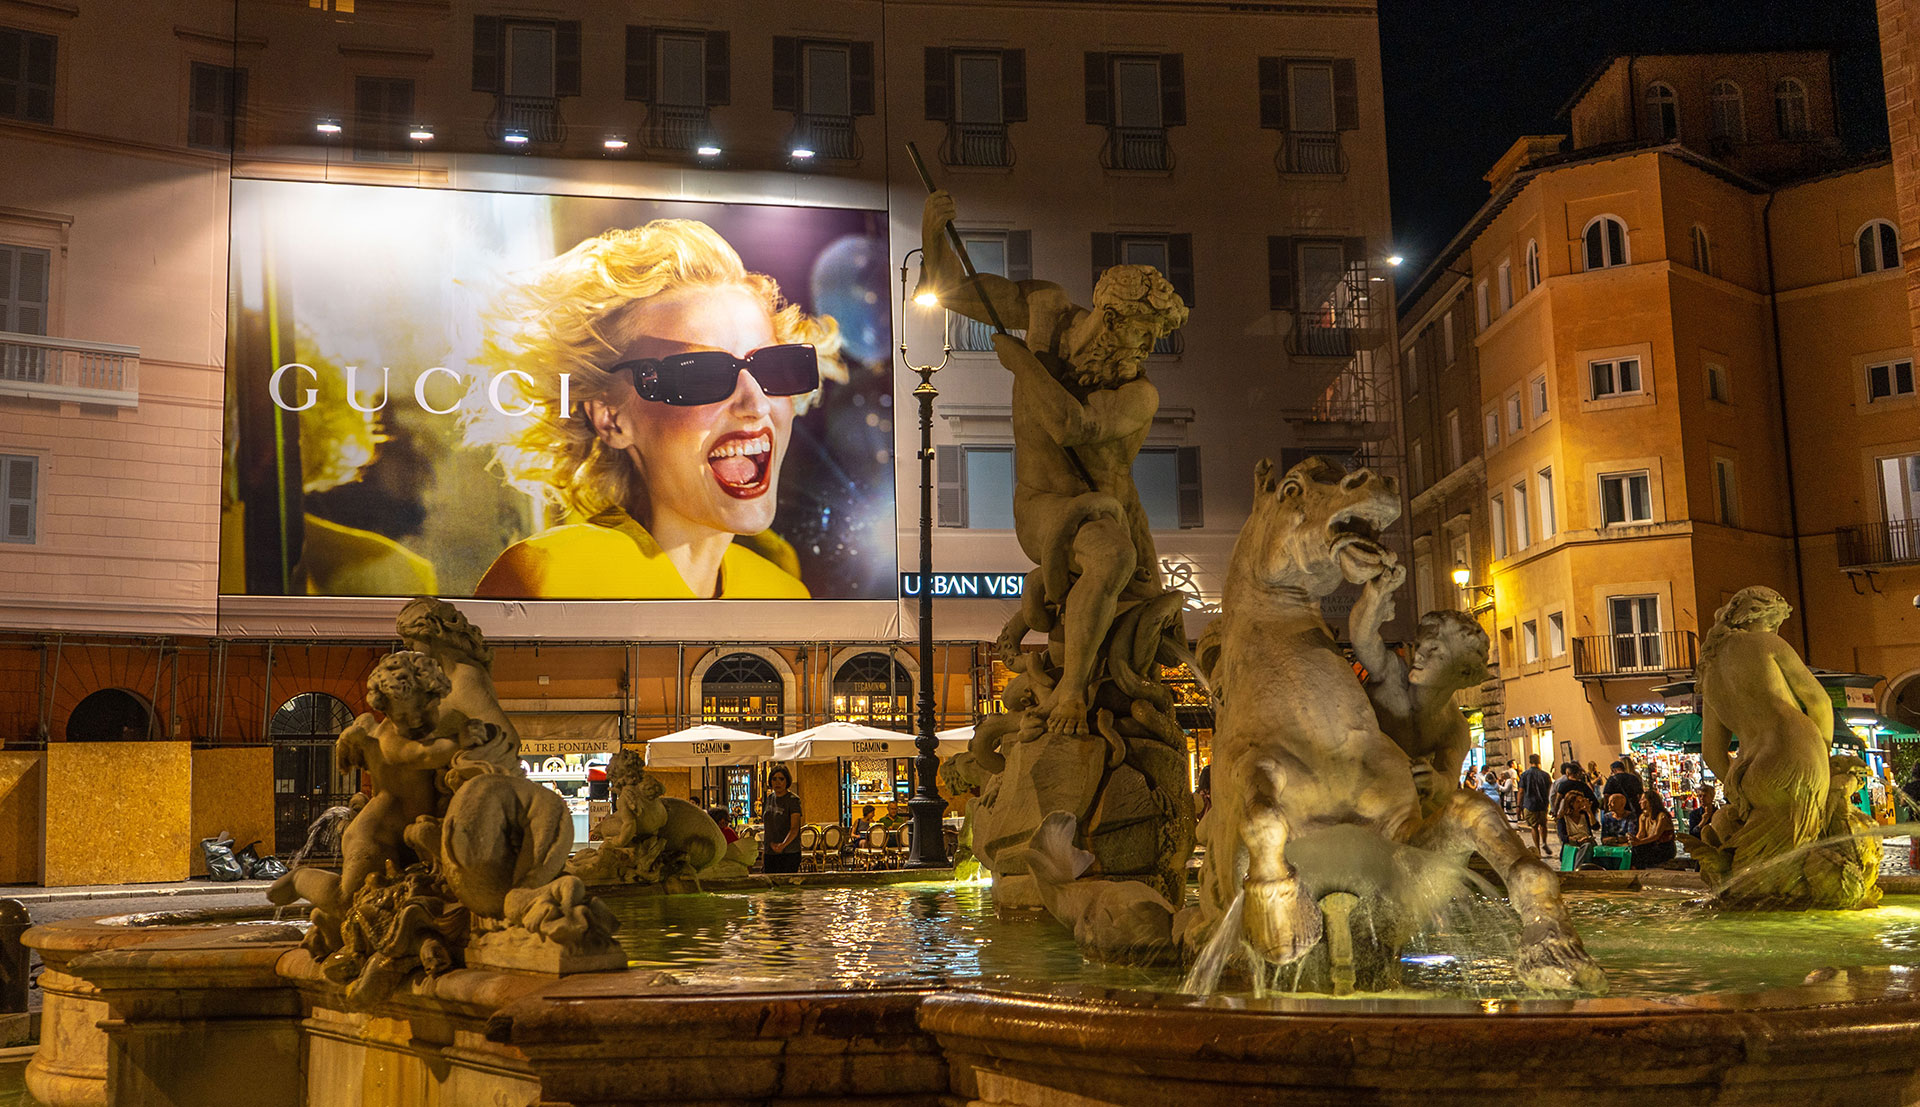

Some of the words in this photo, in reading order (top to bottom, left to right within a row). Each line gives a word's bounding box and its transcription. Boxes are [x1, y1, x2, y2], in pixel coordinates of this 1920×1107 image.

[269, 363, 572, 419] GUCCI
[904, 575, 978, 595] UBAN
[535, 743, 556, 752] TRE
[558, 742, 609, 752] FONTANE
